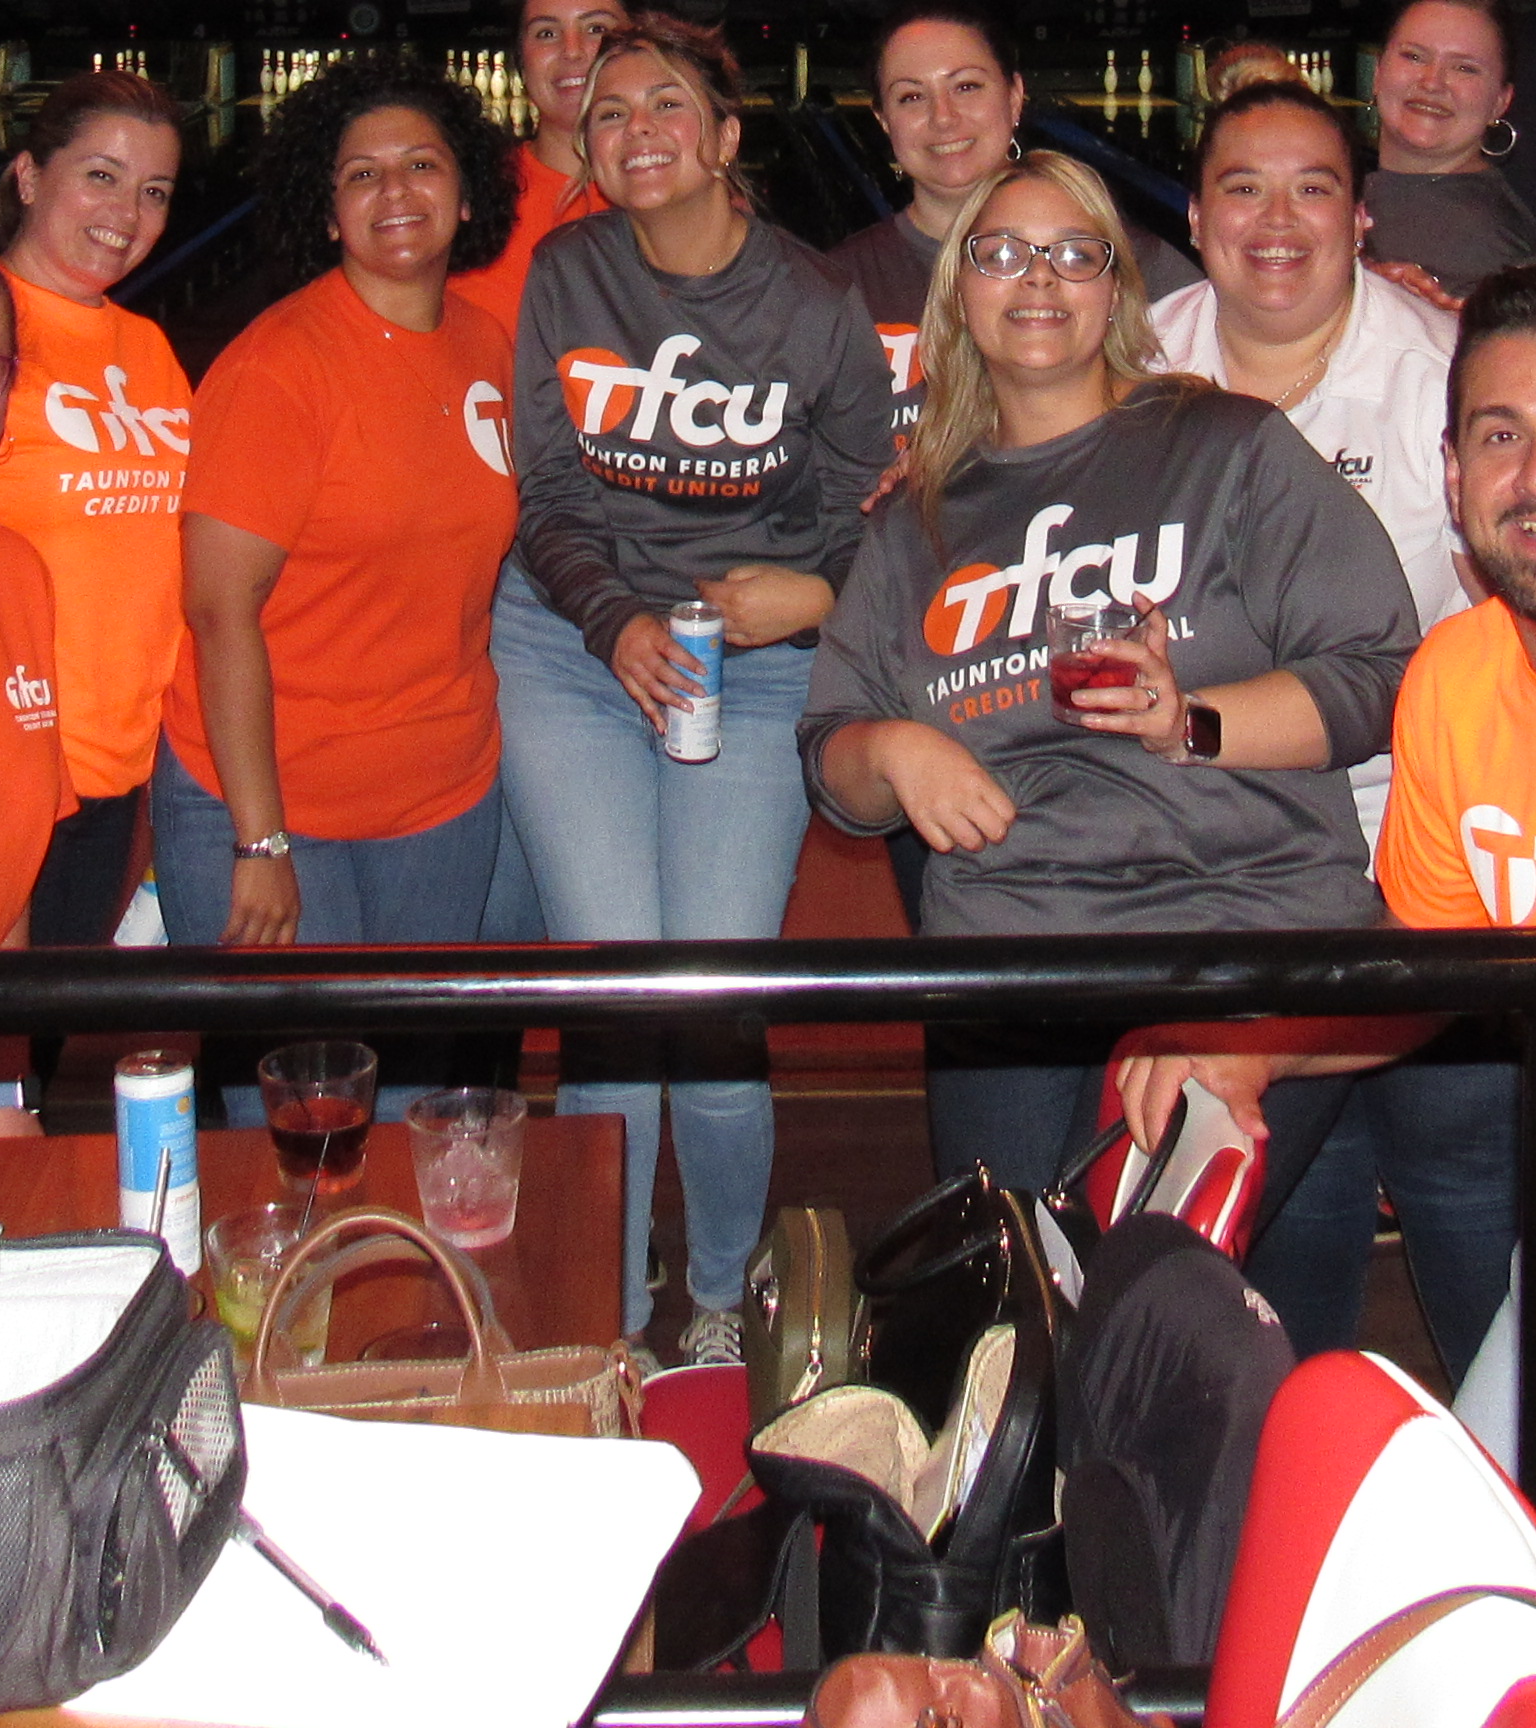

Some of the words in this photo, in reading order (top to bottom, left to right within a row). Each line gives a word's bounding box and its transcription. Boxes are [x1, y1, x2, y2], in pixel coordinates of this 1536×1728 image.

[575, 428, 667, 473] AUNTON
[679, 446, 789, 479] FEDERAL
[1334, 447, 1374, 475] fcu
[59, 470, 170, 493] TAUNTON
[582, 454, 659, 492] CREDIT
[667, 479, 761, 498] UNION
[84, 495, 161, 516] CREDIT
[926, 645, 1049, 706] TAUNTON
[948, 678, 1042, 724] CREDIT
